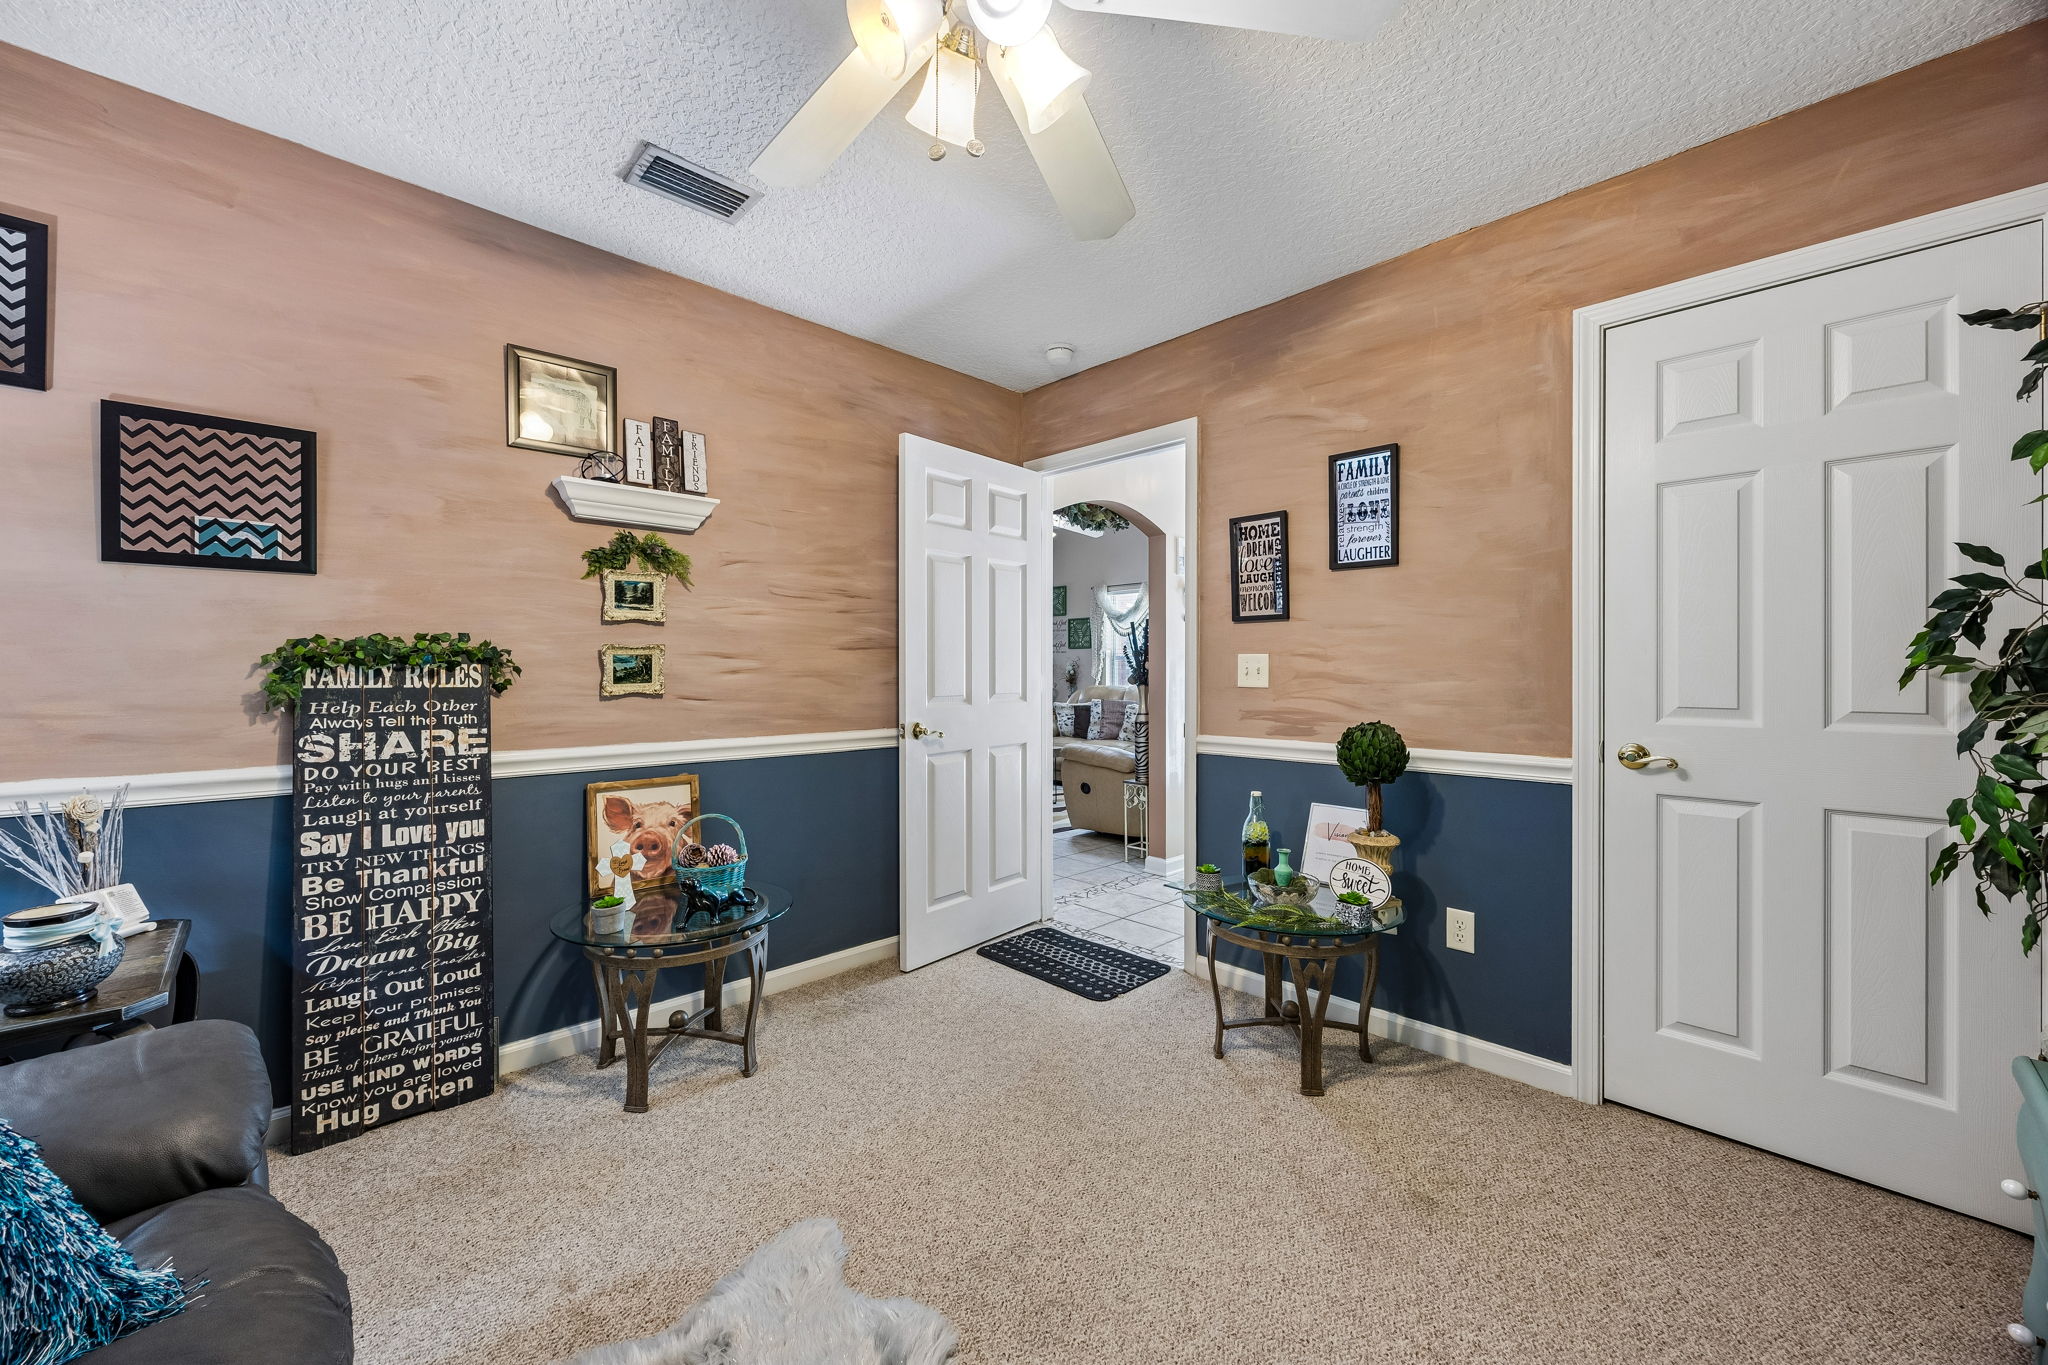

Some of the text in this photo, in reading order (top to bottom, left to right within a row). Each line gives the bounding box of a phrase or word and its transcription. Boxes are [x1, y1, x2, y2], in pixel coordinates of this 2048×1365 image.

[634, 425, 645, 480] FAITH
[662, 421, 674, 492] FAMILY
[1338, 455, 1391, 482] FAMILY
[1359, 478, 1376, 487] STRENGTH
[1367, 488, 1388, 496] children
[1347, 499, 1389, 522] LOVE
[1239, 522, 1280, 541] HOME
[1347, 523, 1383, 533] strength
[1347, 534, 1382, 547] forever
[1240, 546, 1274, 573] love
[1339, 545, 1390, 562] LAUGHTER
[1240, 572, 1275, 584] LAUGH
[303, 664, 482, 688] FAMILY RULES
[309, 700, 477, 717] Help Each Other
[310, 714, 477, 729] Always Tell the Truth
[297, 728, 488, 763] SHARE
[304, 758, 479, 781] DO YOUR BEST
[303, 785, 482, 809] Listen to your parents
[304, 774, 480, 794] Pay with hugs and kisses
[303, 799, 482, 826] Laugh at yourself
[300, 819, 485, 857] Say I Love you
[302, 843, 485, 874] TRY NEW THINGS
[1346, 861, 1370, 874] HOME
[301, 855, 485, 896] Be Thankful
[1332, 872, 1385, 894] sweet
[305, 876, 482, 911] Show Compassion
[301, 889, 484, 942] BE HAPPY
[307, 916, 480, 956] Love Each Other
[306, 933, 481, 977] Dream Big
[301, 970, 385, 993] Respect
[388, 966, 417, 977] one
[305, 963, 482, 1015] Laugh Out Loud
[306, 985, 481, 1030] Keep your promises
[305, 998, 482, 1046] Say please and Thank You
[304, 1011, 483, 1070] BE GRATEFUL
[302, 1028, 483, 1082] Think of others before yourself
[301, 1042, 483, 1101] USE KIND WORDS
[301, 1057, 482, 1116] Know you are loved
[316, 1075, 473, 1134] Hug Often
